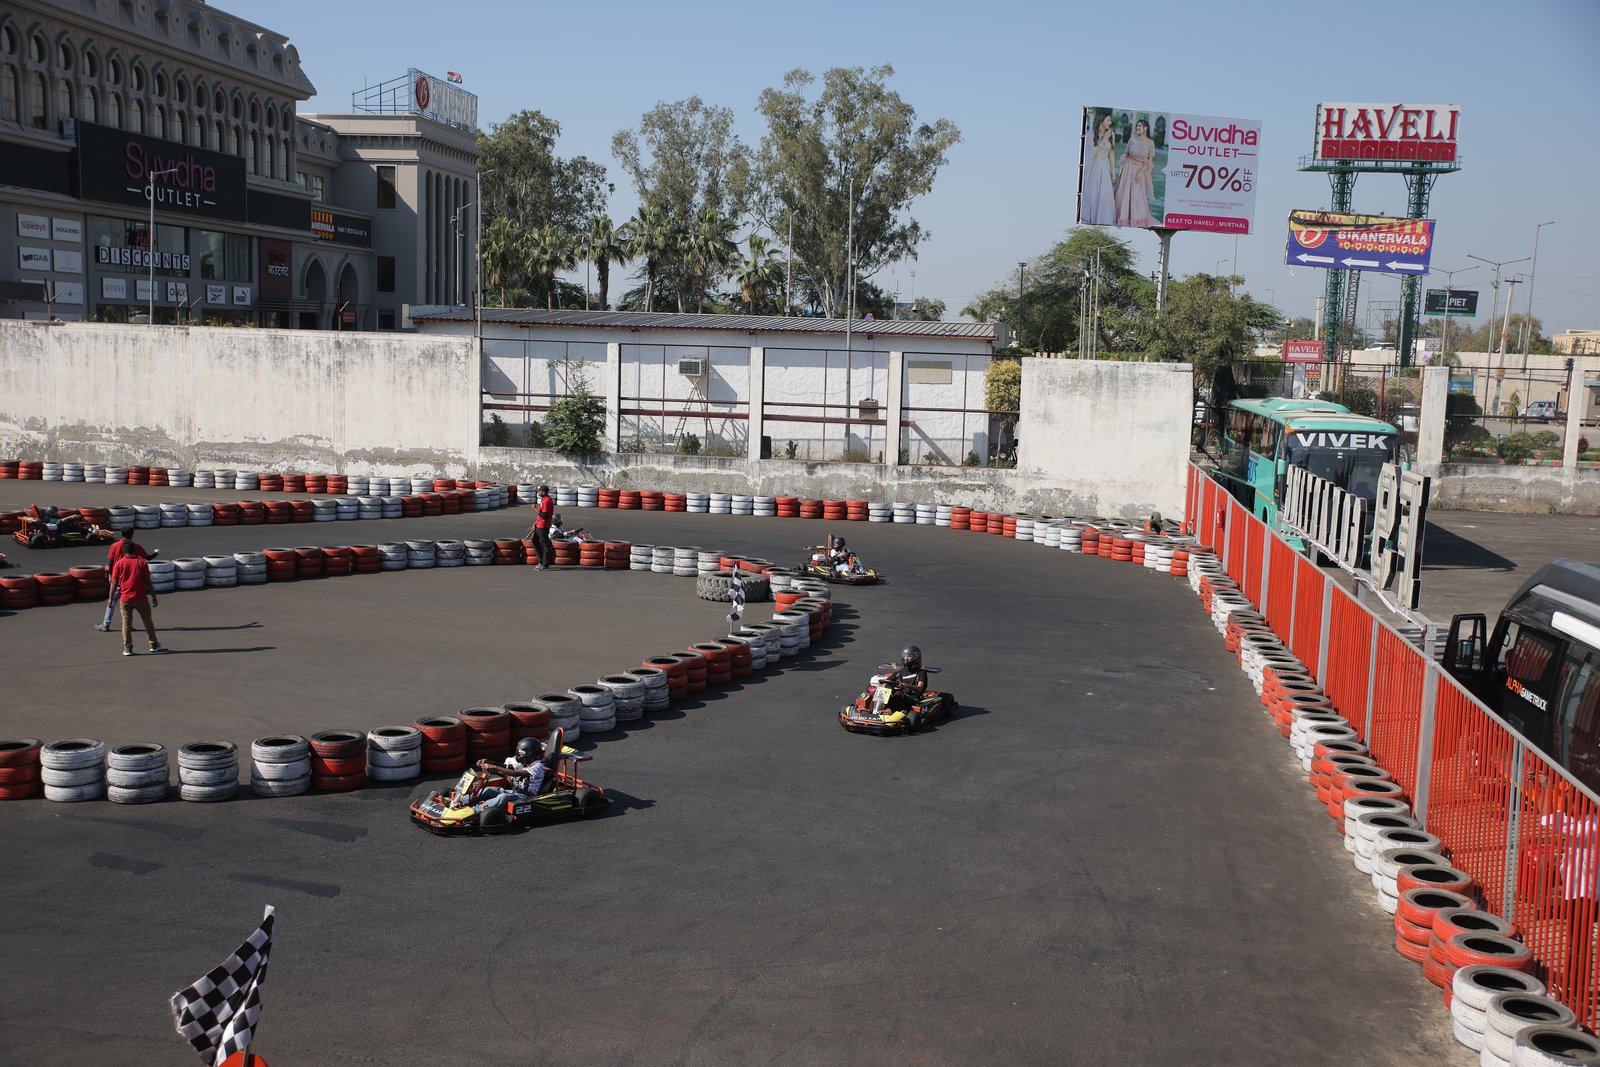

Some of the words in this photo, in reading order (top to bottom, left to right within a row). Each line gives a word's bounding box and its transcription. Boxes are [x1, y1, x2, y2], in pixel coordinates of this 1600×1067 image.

[1322, 103, 1459, 140] HAVELI
[1172, 120, 1257, 146] Suvidha
[1187, 145, 1239, 158] OUTLET
[126, 141, 216, 192] Suvidha
[1171, 170, 1190, 178] UPTO
[1183, 164, 1242, 192] 70%
[1243, 168, 1252, 192] OFF
[145, 185, 201, 208] OUTLET
[1338, 230, 1427, 246] BIKANERVALA
[33, 254, 48, 262] GAS
[100, 248, 189, 269] DISCOUNTS
[104, 284, 125, 292] GUESS
[1448, 297, 1468, 307] PIET
[1289, 345, 1319, 353] HAVELI
[1296, 432, 1389, 450] VIVEK
[515, 804, 532, 814] 22
